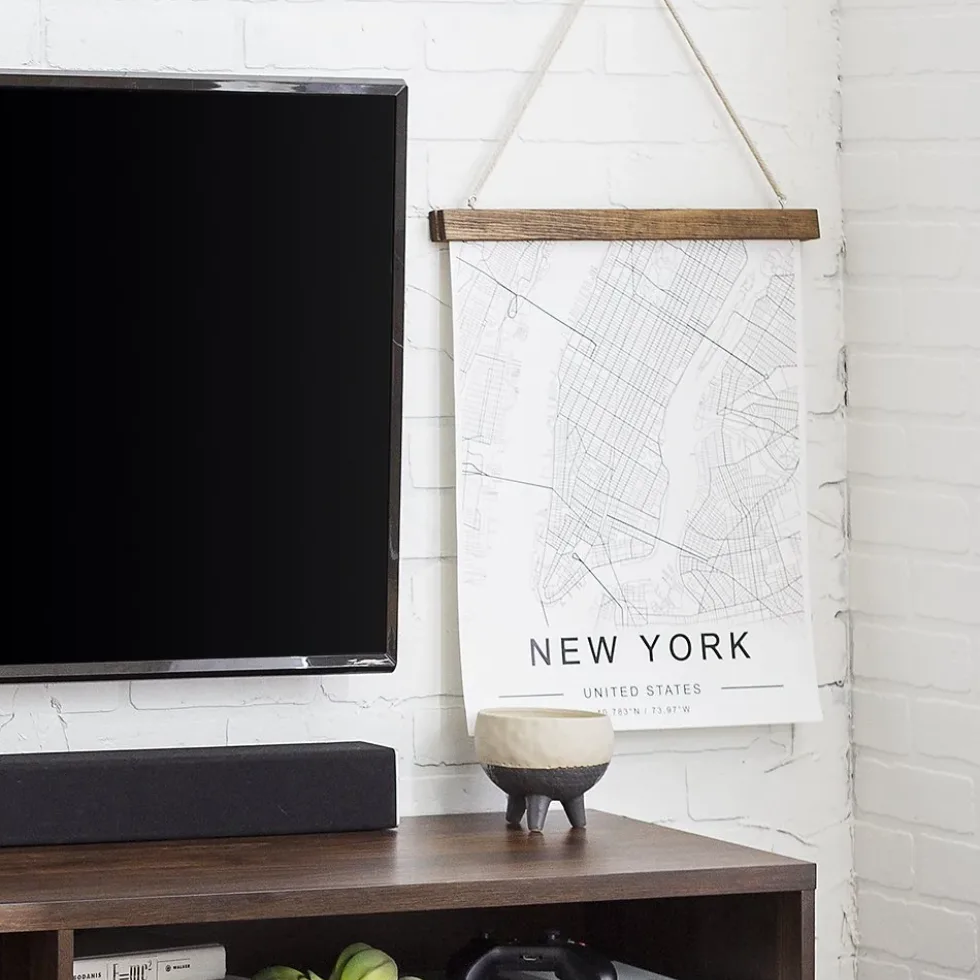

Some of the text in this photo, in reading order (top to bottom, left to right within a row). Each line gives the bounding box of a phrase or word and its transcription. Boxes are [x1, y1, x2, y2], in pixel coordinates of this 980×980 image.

[530, 631, 751, 666] NEW YORK
[583, 683, 701, 699] UNITED STATES
